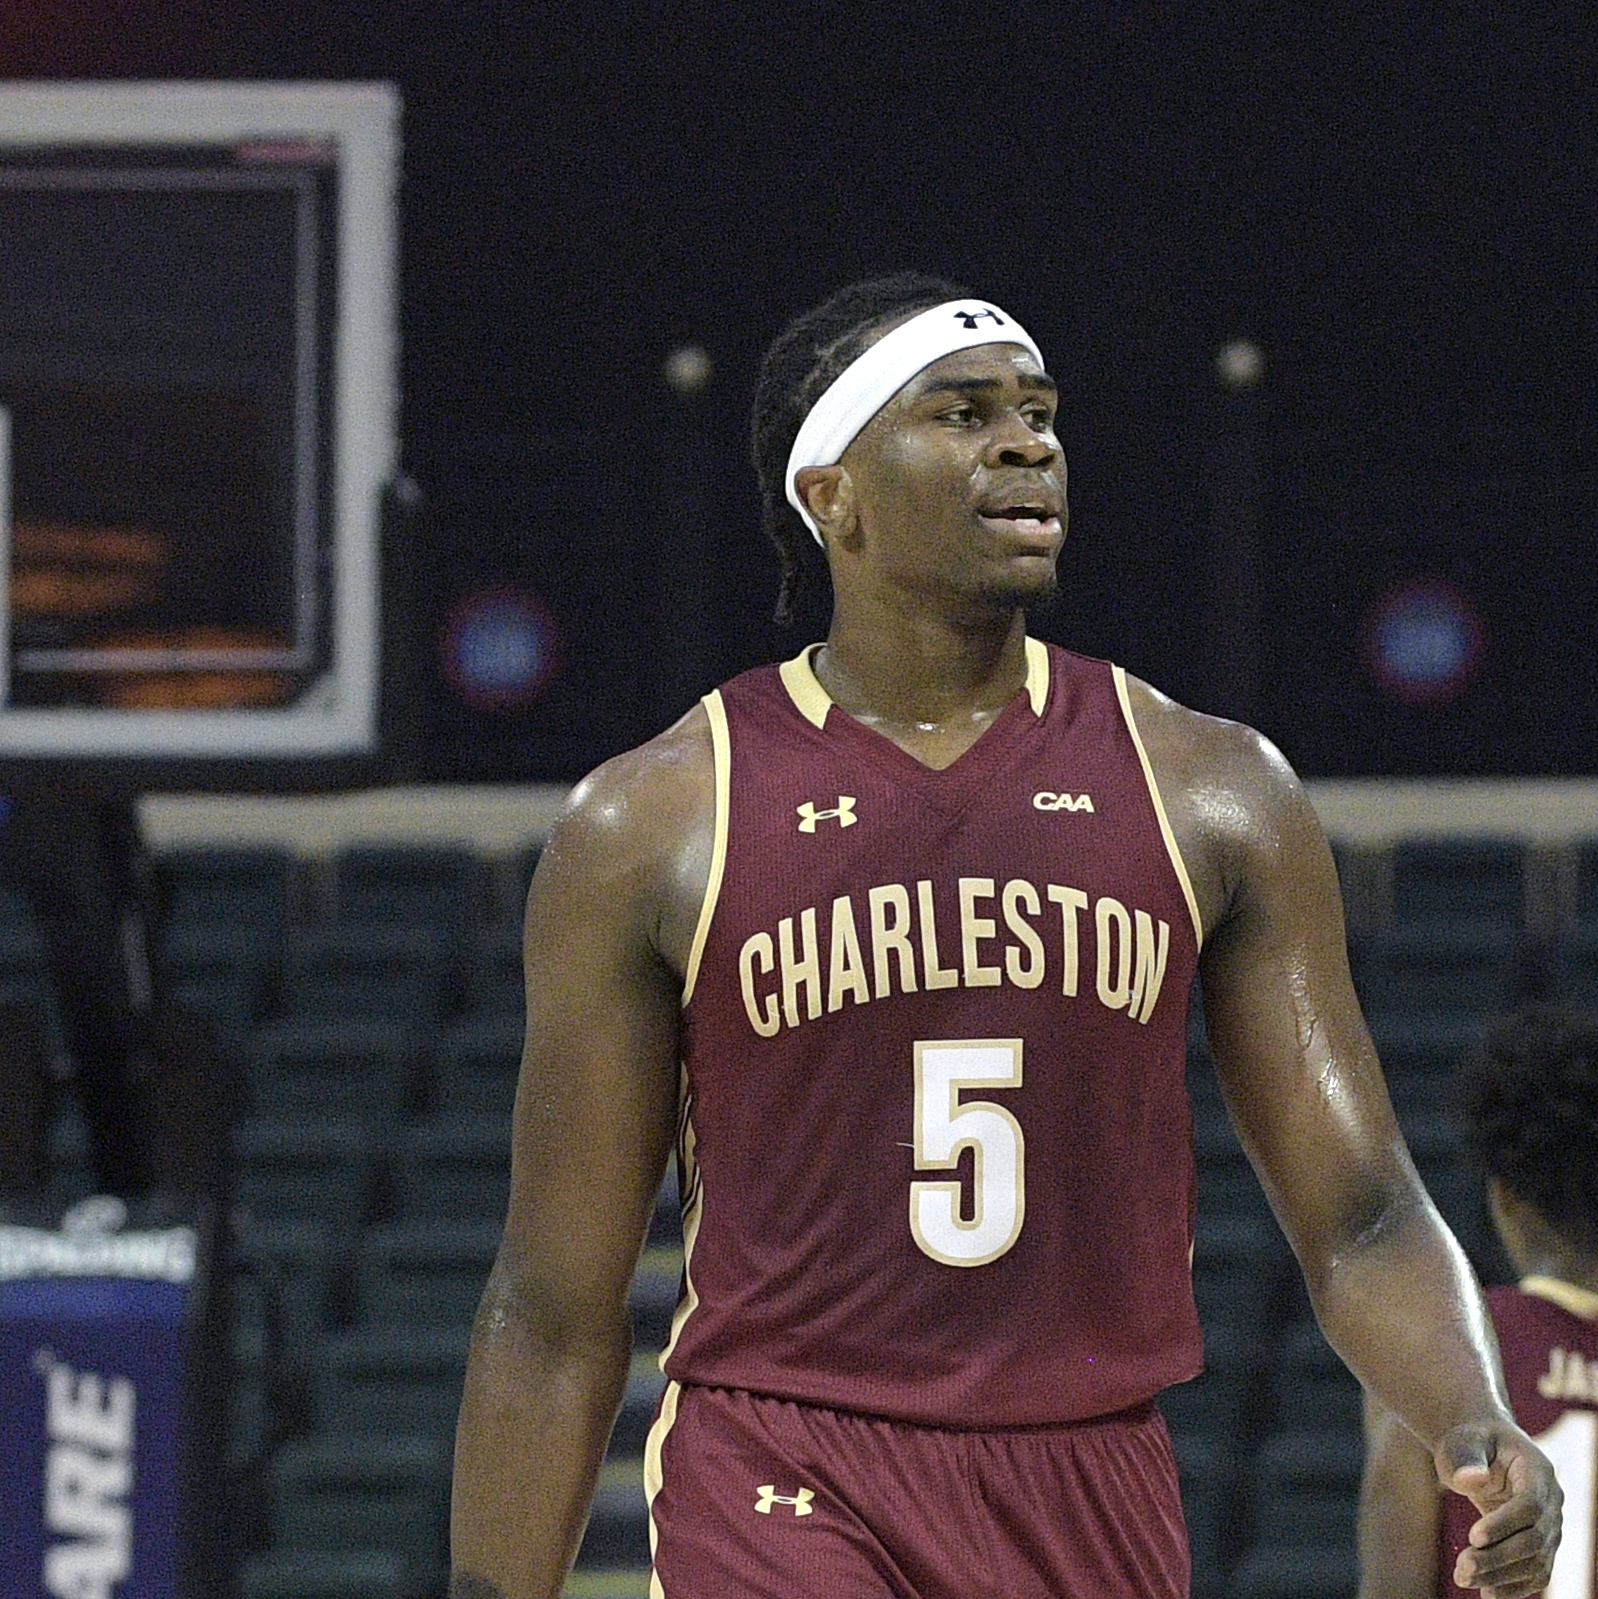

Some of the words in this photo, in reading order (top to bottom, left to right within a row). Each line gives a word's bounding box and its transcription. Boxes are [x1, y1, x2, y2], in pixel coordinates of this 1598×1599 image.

[1033, 791, 1094, 814] CAA
[738, 877, 1170, 1038] CHARLESTON
[909, 1037, 1026, 1268] 5
